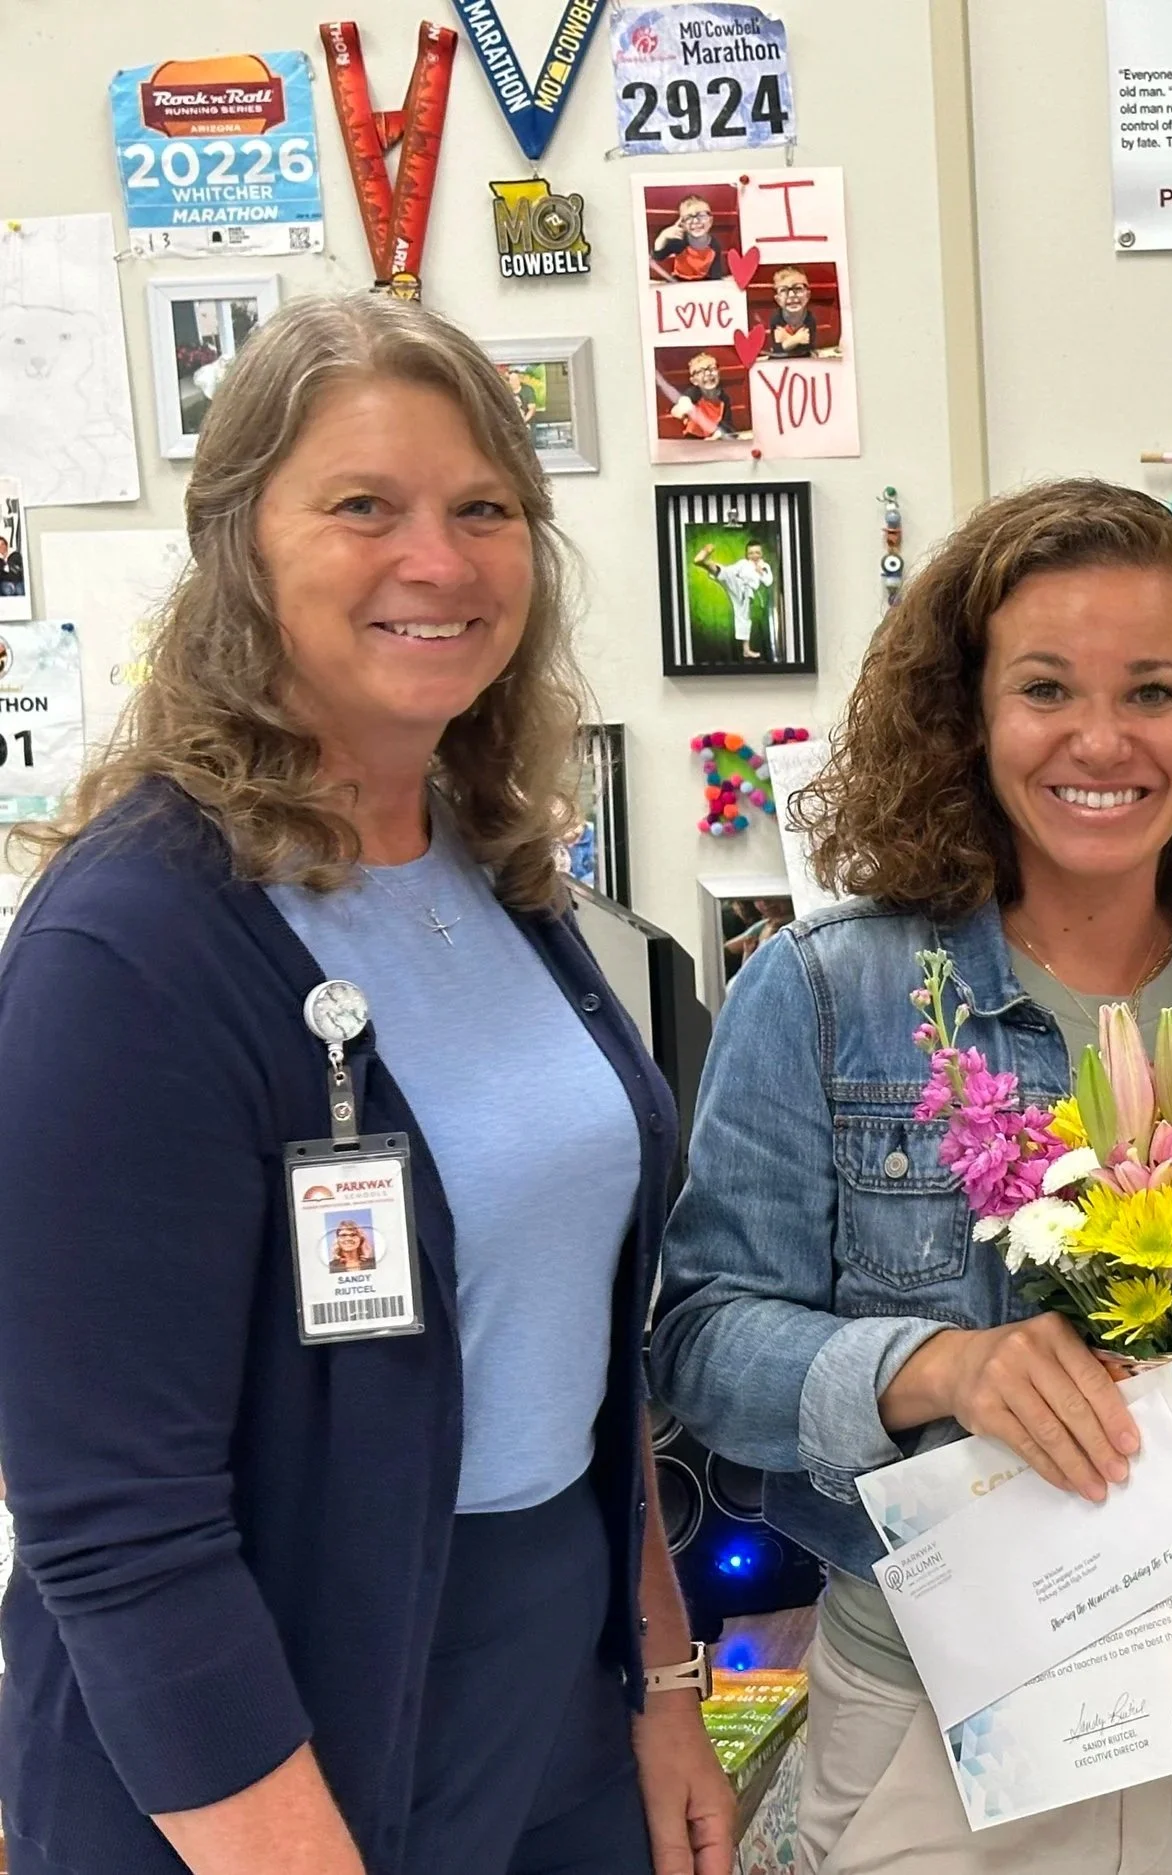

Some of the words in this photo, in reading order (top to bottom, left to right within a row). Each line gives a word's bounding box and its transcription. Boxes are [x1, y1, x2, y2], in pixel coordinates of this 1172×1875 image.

[554, 0, 599, 66] COWBE
[464, 1, 531, 114] MARATHON
[681, 37, 780, 65] Marathon
[153, 91, 209, 106] Rock
[226, 89, 273, 103] Roll
[1119, 86, 1135, 97] old
[1139, 86, 1165, 97] man.
[165, 107, 219, 115] RUNNING
[222, 105, 263, 114] SERIES
[622, 74, 788, 141] 2924
[1120, 103, 1136, 114] old
[1140, 103, 1163, 113] man
[191, 124, 241, 133] ARIZONA
[1121, 120, 1159, 131] control
[1162, 119, 1172, 130] of
[1121, 138, 1134, 150] by
[1137, 137, 1160, 149] fate.
[123, 138, 314, 188] 20226
[172, 186, 272, 202] WHITCHER
[173, 206, 279, 224] MARATHON
[754, 180, 828, 243] I
[501, 250, 589, 277] COWBELL
[758, 365, 832, 435] YOU
[336, 1179, 393, 1192] PARKWAY
[344, 1191, 388, 1199] SCHOOLS
[335, 1285, 376, 1296] RIUTCEL
[338, 1274, 372, 1284] SANDY
[901, 1541, 937, 1567] PARKWAY
[905, 1552, 943, 1580] ALUMNI
[1050, 1610, 1076, 1631] Sharing
[1122, 1568, 1151, 1589] Building
[1098, 1632, 1123, 1647] create
[1125, 1617, 1172, 1638] experiences
[1057, 1663, 1073, 1676] and
[1074, 1654, 1108, 1671] teachers
[1109, 1651, 1118, 1660] to
[1119, 1646, 1130, 1656] be
[1131, 1642, 1144, 1653] the
[1145, 1635, 1163, 1648] best
[1082, 1738, 1107, 1752] SANDY
[1107, 1729, 1137, 1745] RIUTCEL
[1074, 1751, 1113, 1769] EXECUTIVE
[1114, 1739, 1150, 1757] DIRECTOR
